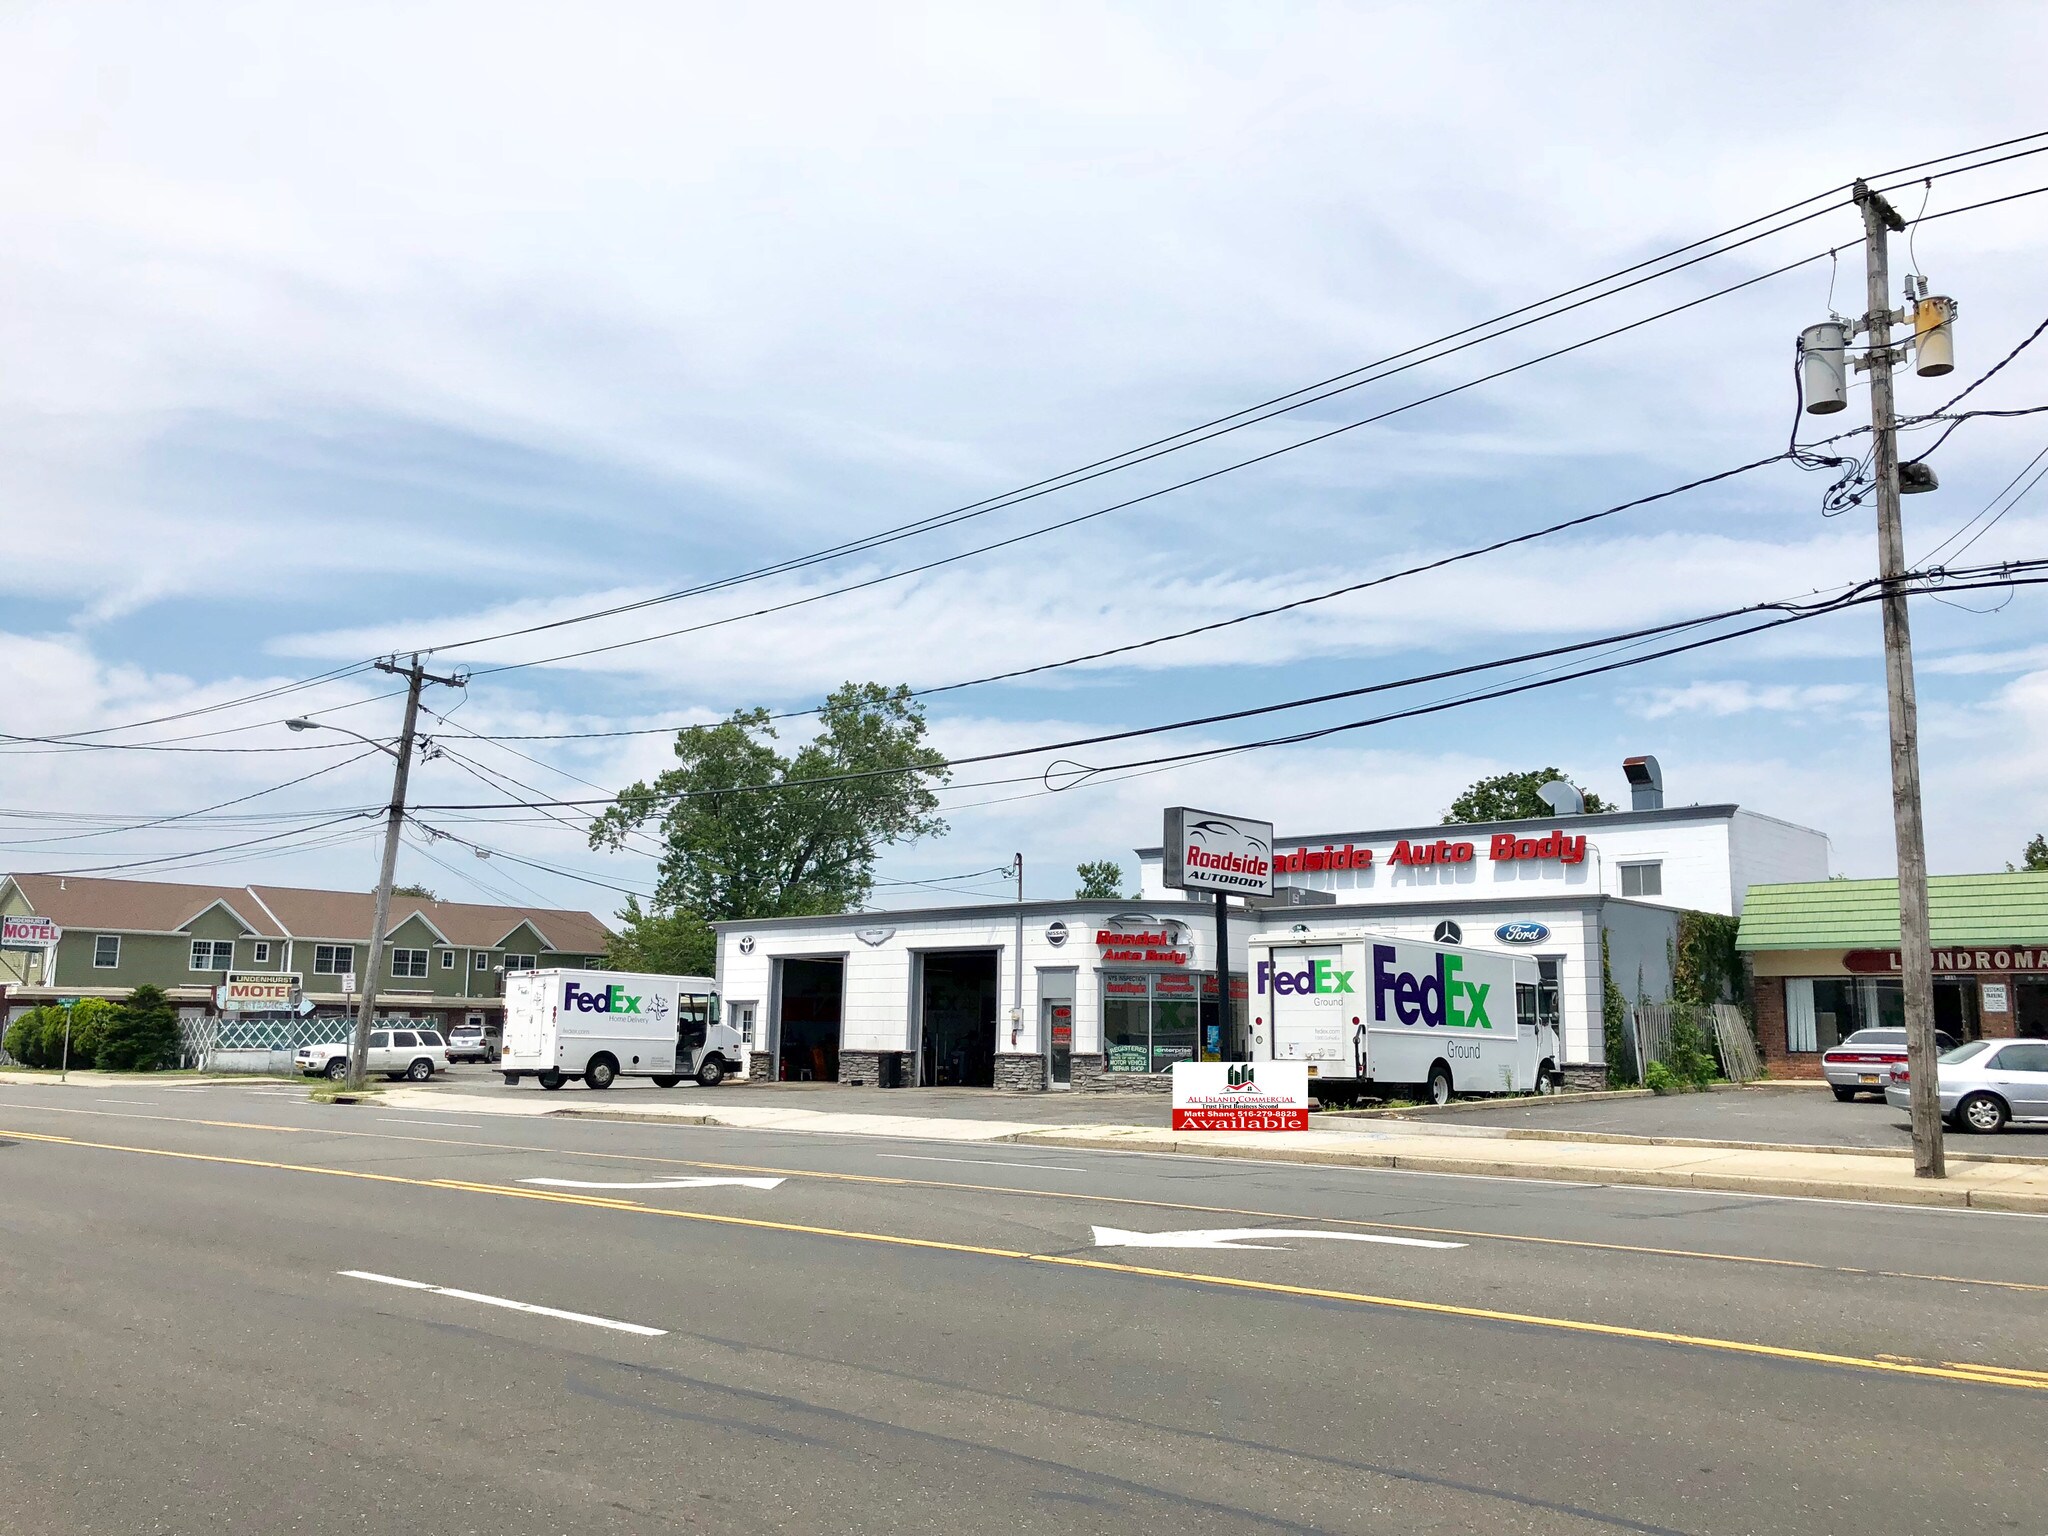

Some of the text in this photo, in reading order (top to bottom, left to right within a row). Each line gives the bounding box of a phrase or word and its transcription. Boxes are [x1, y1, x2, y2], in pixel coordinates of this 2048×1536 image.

[1272, 830, 1587, 873] adside Auto Body
[1186, 845, 1268, 876] Roadside
[1188, 871, 1267, 888] AUTOBODY
[4, 924, 58, 940] MOTEL
[1505, 924, 1539, 941] Ford
[1101, 948, 1187, 965] Auto Body
[1889, 951, 2048, 970] LNDROMA
[236, 975, 293, 983] LINDENHURST
[1257, 960, 1355, 995] FedEx
[1373, 944, 1493, 1029] FedEx
[564, 982, 642, 1013] FedEx
[1314, 998, 1343, 1006] Ground
[609, 1015, 649, 1024] Home Delivery
[1109, 1045, 1148, 1054] REGISTERED
[1447, 1040, 1481, 1059] Ground
